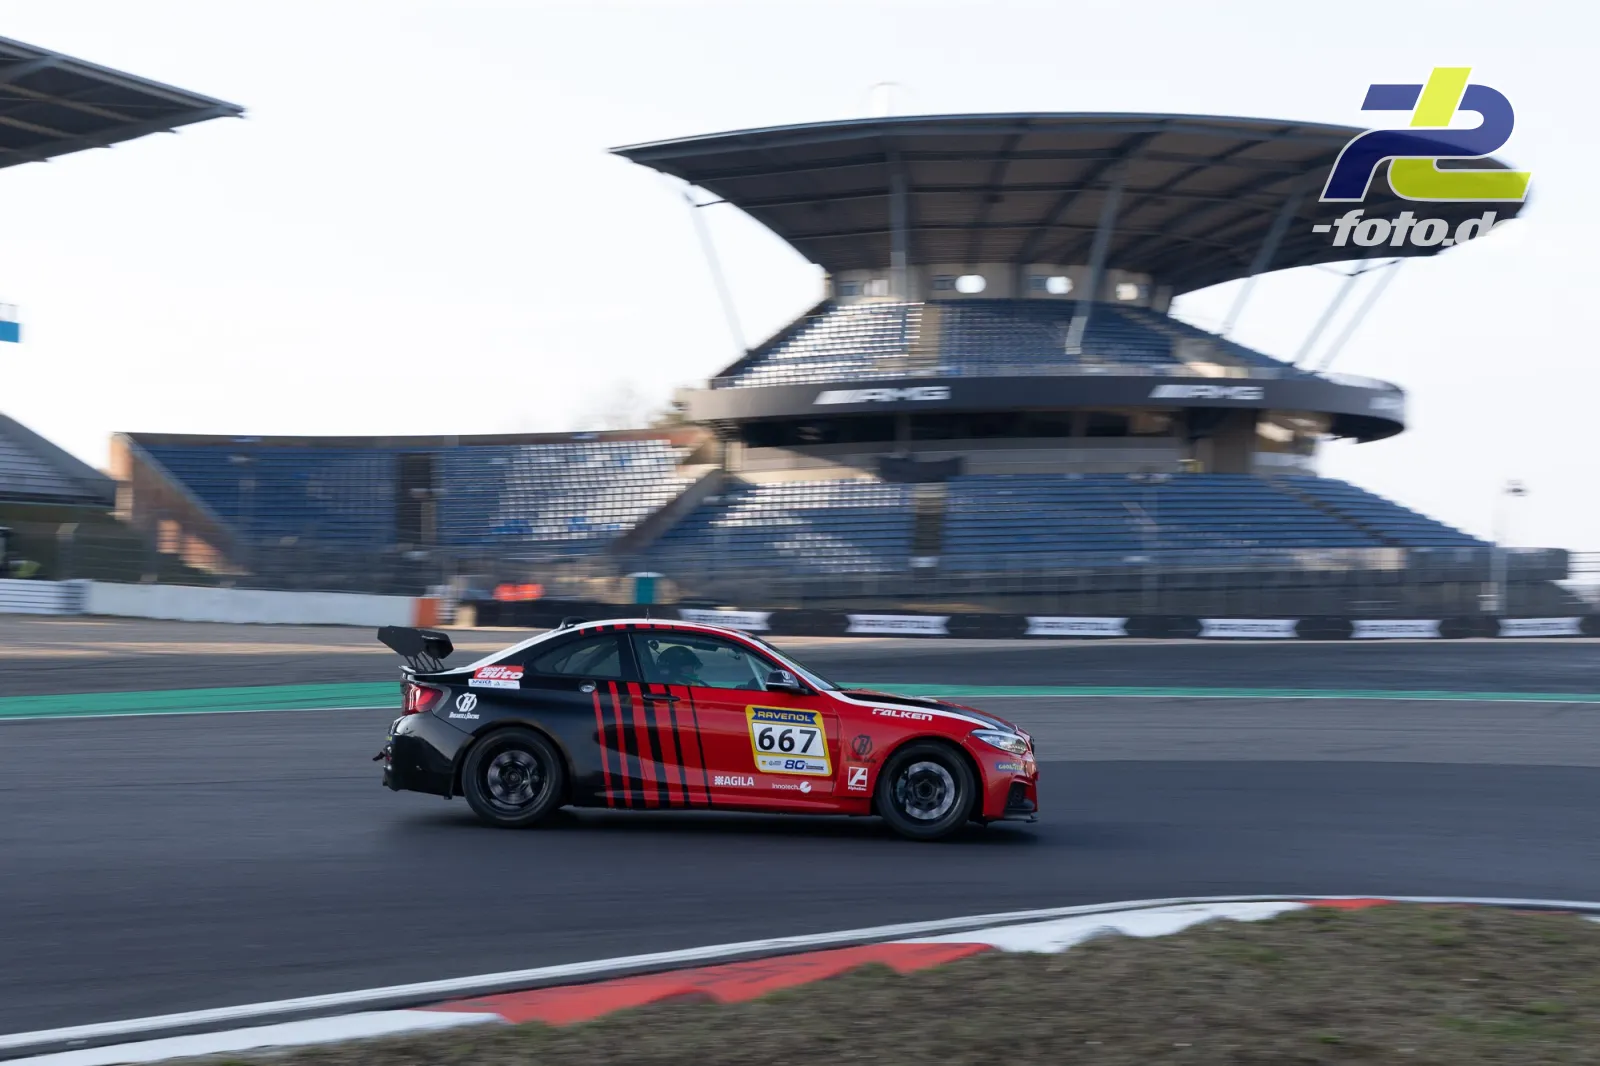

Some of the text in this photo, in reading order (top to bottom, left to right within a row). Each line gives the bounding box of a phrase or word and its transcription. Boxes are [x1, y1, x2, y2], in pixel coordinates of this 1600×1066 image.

[477, 670, 524, 680] auto
[757, 711, 811, 722] RAVENOL
[872, 708, 933, 721] FALKEN
[758, 726, 817, 753] 667
[724, 776, 755, 787] AGILA
